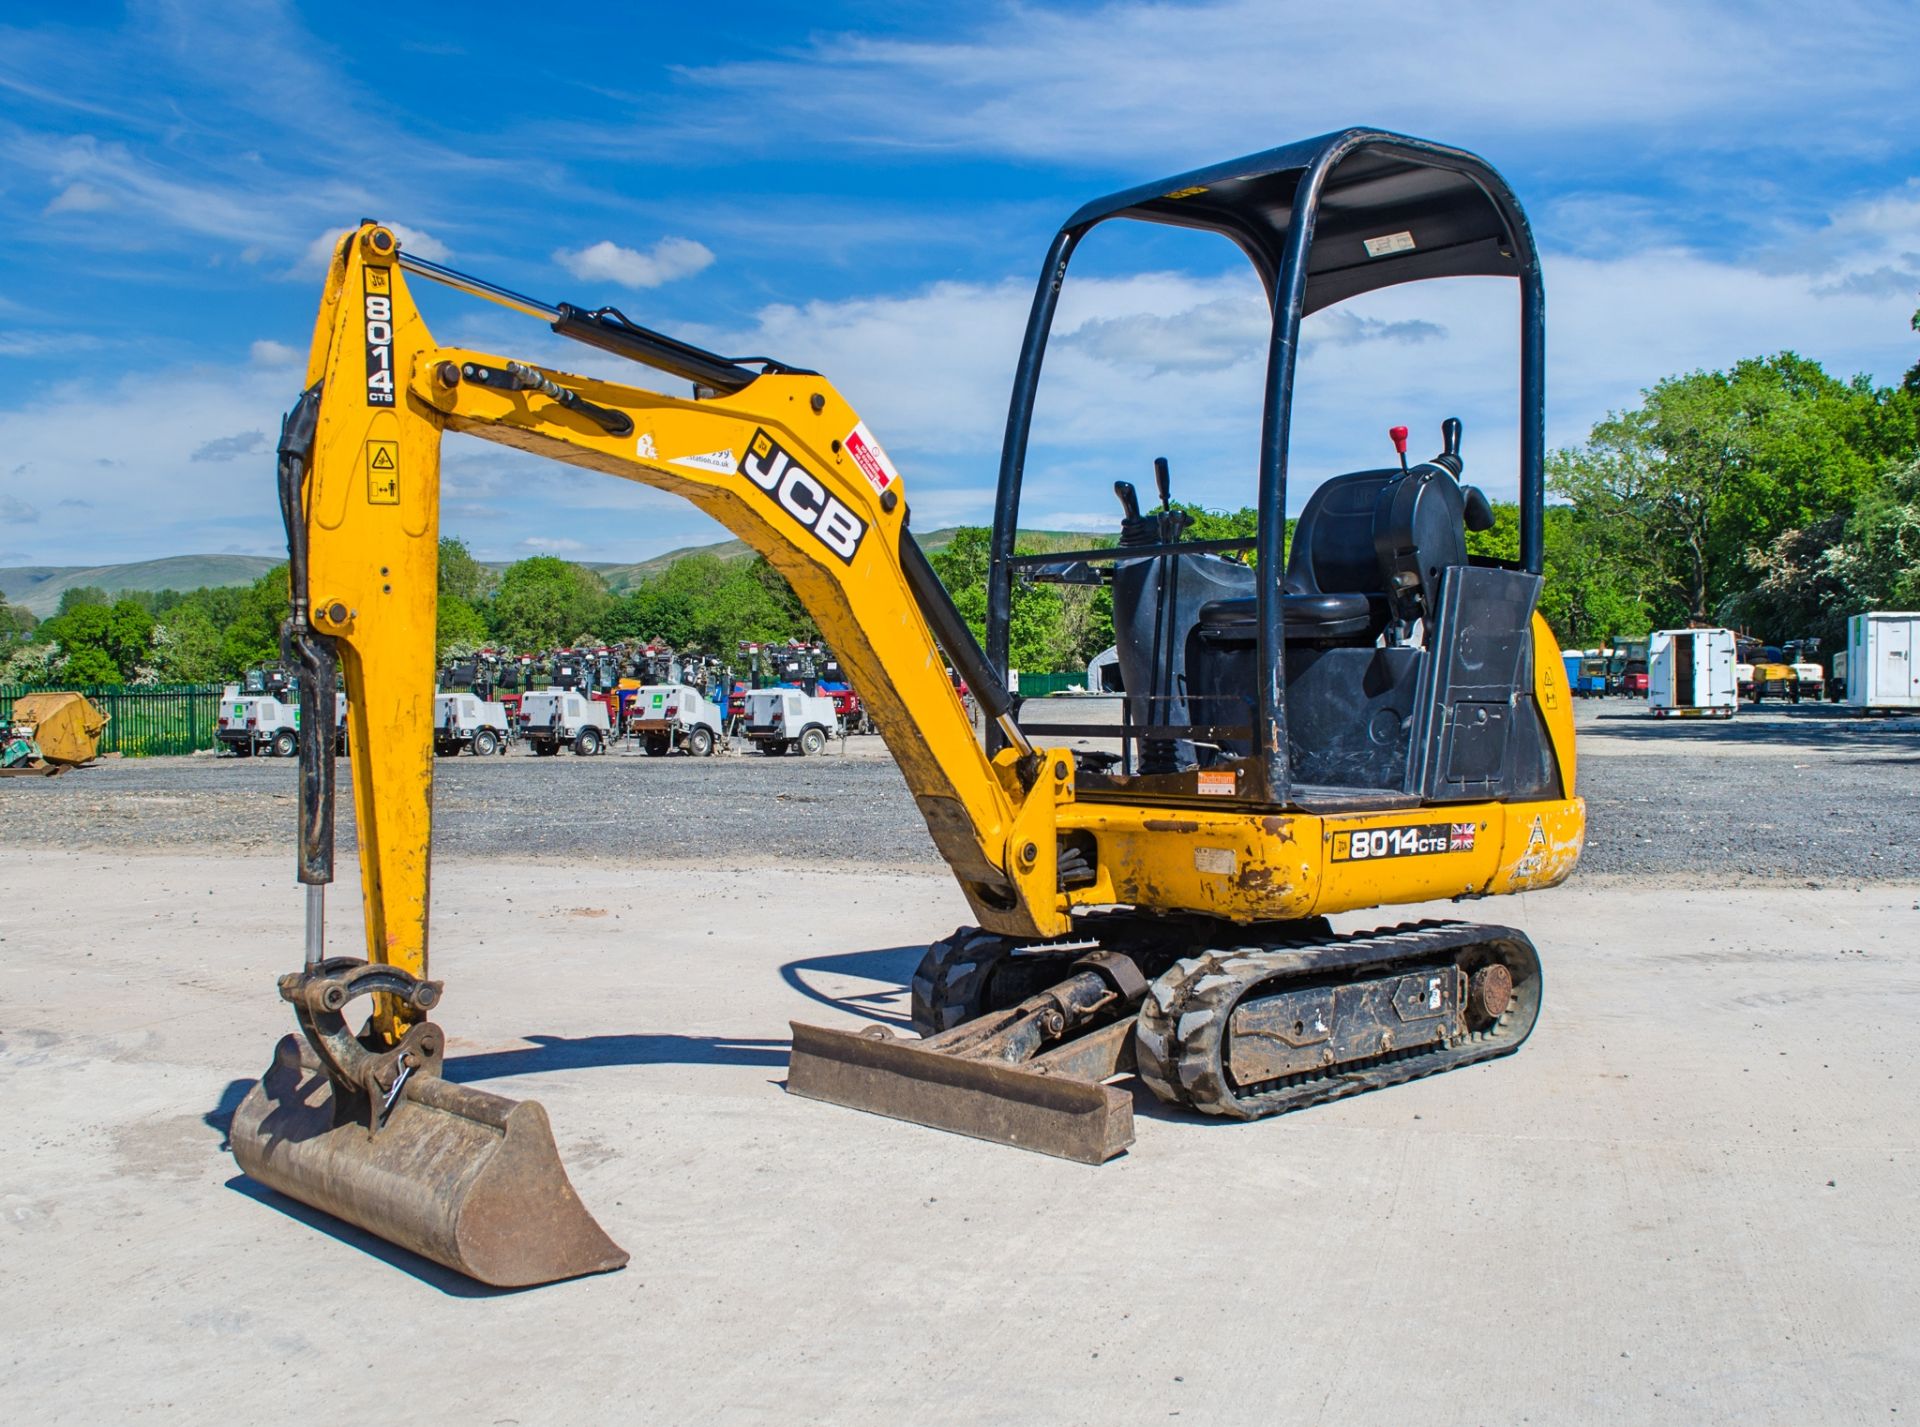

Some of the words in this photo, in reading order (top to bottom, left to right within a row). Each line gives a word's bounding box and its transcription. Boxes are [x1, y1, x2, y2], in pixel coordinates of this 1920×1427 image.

[366, 297, 393, 393] 8014
[369, 393, 393, 402] CTS
[744, 451, 862, 558] JCB
[1351, 828, 1418, 859] 8014
[1418, 838, 1447, 852] CTS
